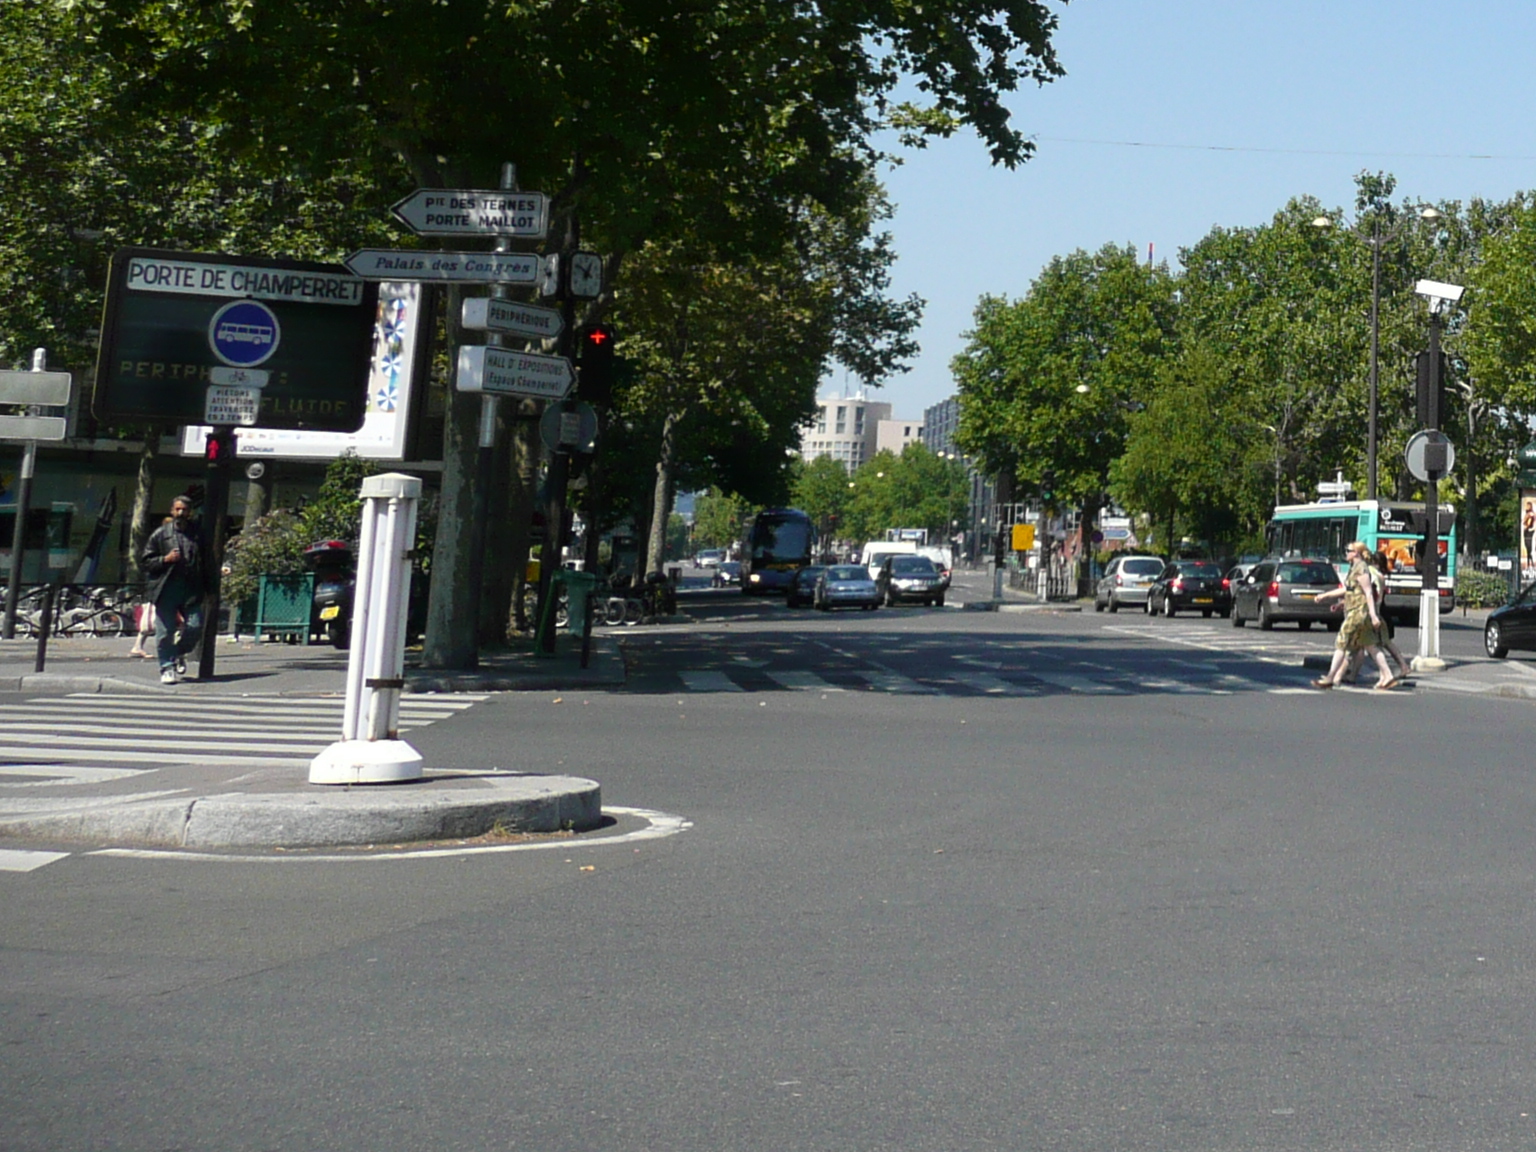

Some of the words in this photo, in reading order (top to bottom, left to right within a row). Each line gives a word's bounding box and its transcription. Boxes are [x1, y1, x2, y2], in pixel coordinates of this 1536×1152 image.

[450, 198, 476, 210] DES
[483, 200, 536, 212] TERNES
[425, 214, 470, 227] PORTE
[479, 216, 535, 228] MAILLOT
[375, 257, 424, 270] Palais
[432, 258, 458, 271] des
[465, 259, 531, 275] Congrès
[129, 262, 196, 288] PORTE
[200, 268, 227, 290] DE
[231, 272, 363, 300] CHAMPERRET
